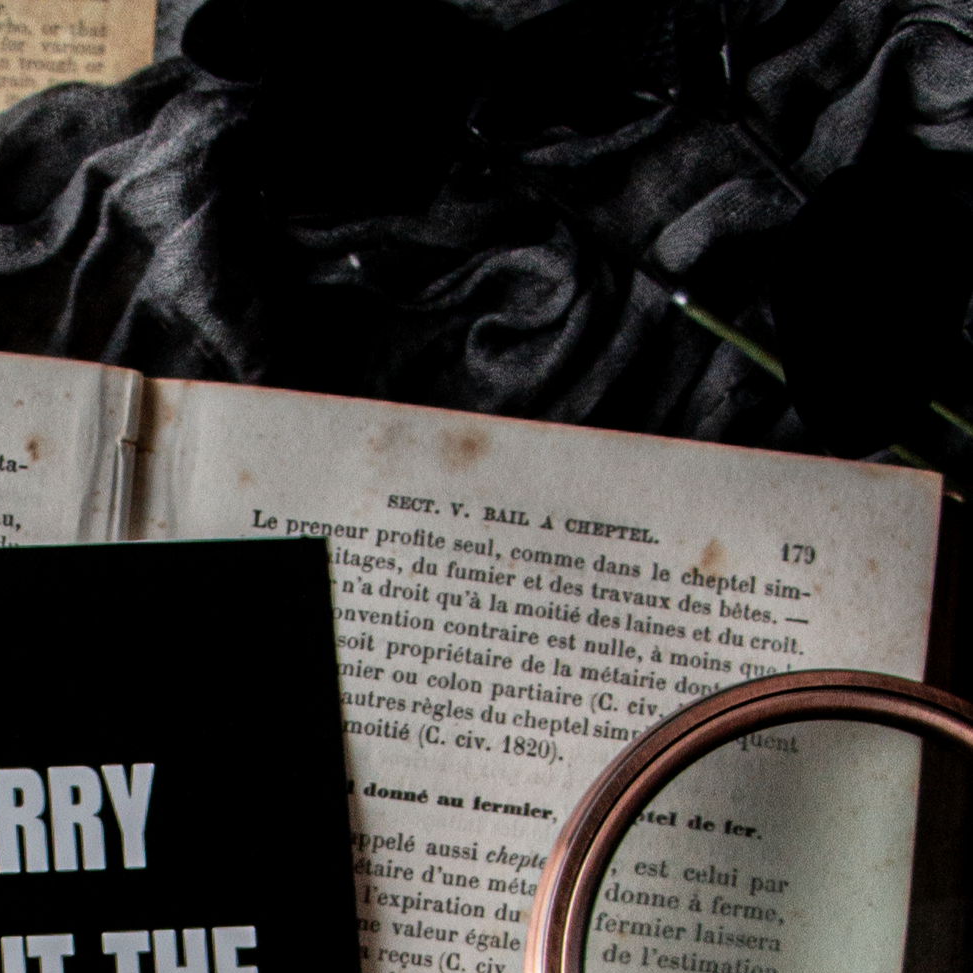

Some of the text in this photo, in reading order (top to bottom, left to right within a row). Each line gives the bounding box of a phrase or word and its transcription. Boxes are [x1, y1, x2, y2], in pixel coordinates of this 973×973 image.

[386, 494, 660, 545] SECT. V. BAIL A CHEPTEL.
[252, 508, 812, 601] Le preneur profite seul, comme dans le cheptel sim-
[781, 542, 817, 566] 179
[342, 576, 374, 597] n'a
[378, 578, 430, 603] droit
[435, 589, 482, 612] qu'à
[488, 593, 509, 614] la
[513, 601, 582, 624] moitié
[585, 607, 621, 630] des
[625, 612, 687, 639] laines
[691, 626, 712, 644] et
[717, 626, 744, 648] du
[345, 715, 564, 765] moitié (C. civ. 1820).
[363, 781, 557, 823] donné au fermier,
[604, 882, 785, 926] donne à ferme,
[391, 920, 522, 952] valeur égale
[594, 911, 781, 953] fermier laissera
